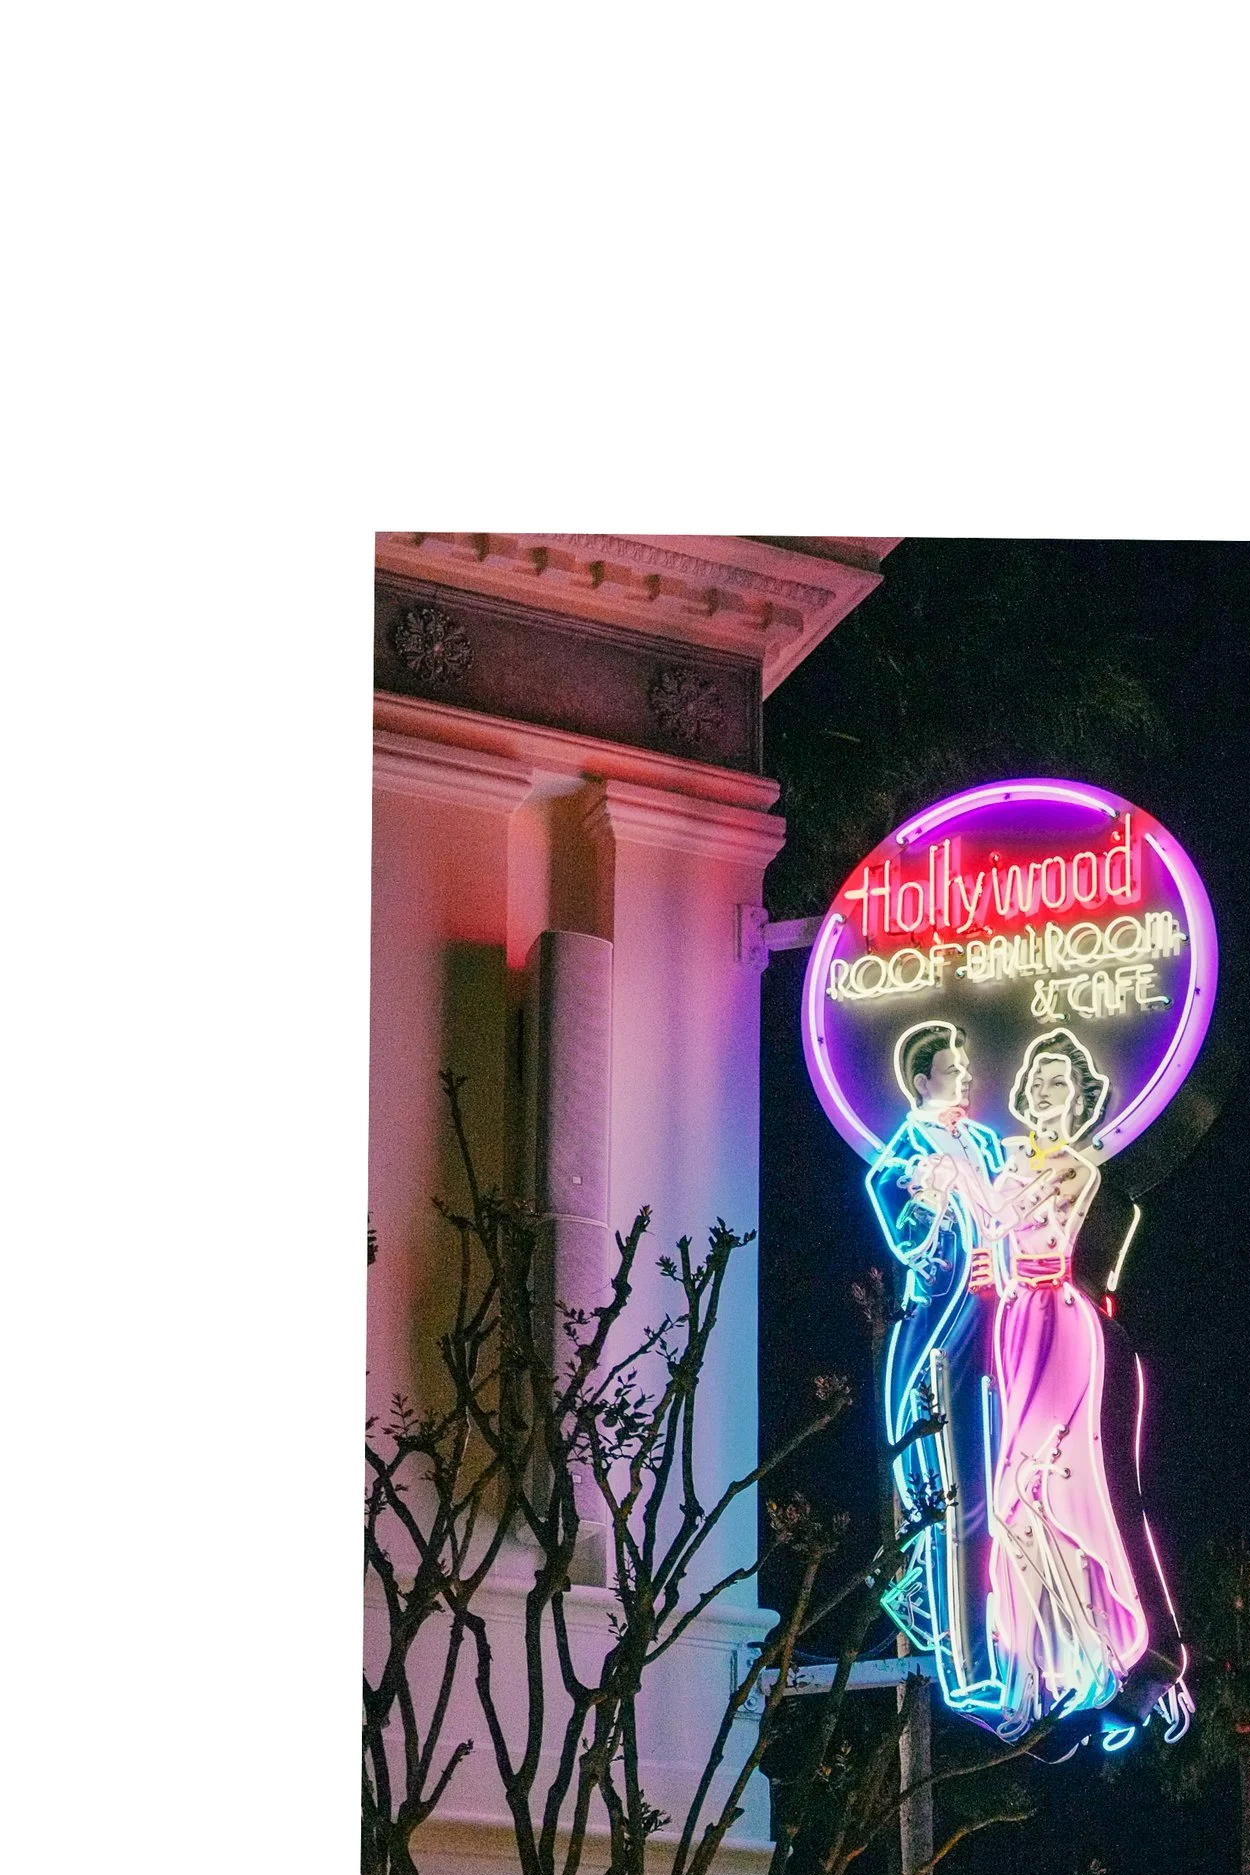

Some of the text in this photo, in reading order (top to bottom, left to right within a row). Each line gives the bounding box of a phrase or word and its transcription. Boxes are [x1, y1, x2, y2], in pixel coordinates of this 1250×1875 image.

[845, 812, 1136, 937] Hollywood
[826, 910, 1188, 1000] ROOF BALLROOM
[1030, 963, 1172, 1021] & CAFE
